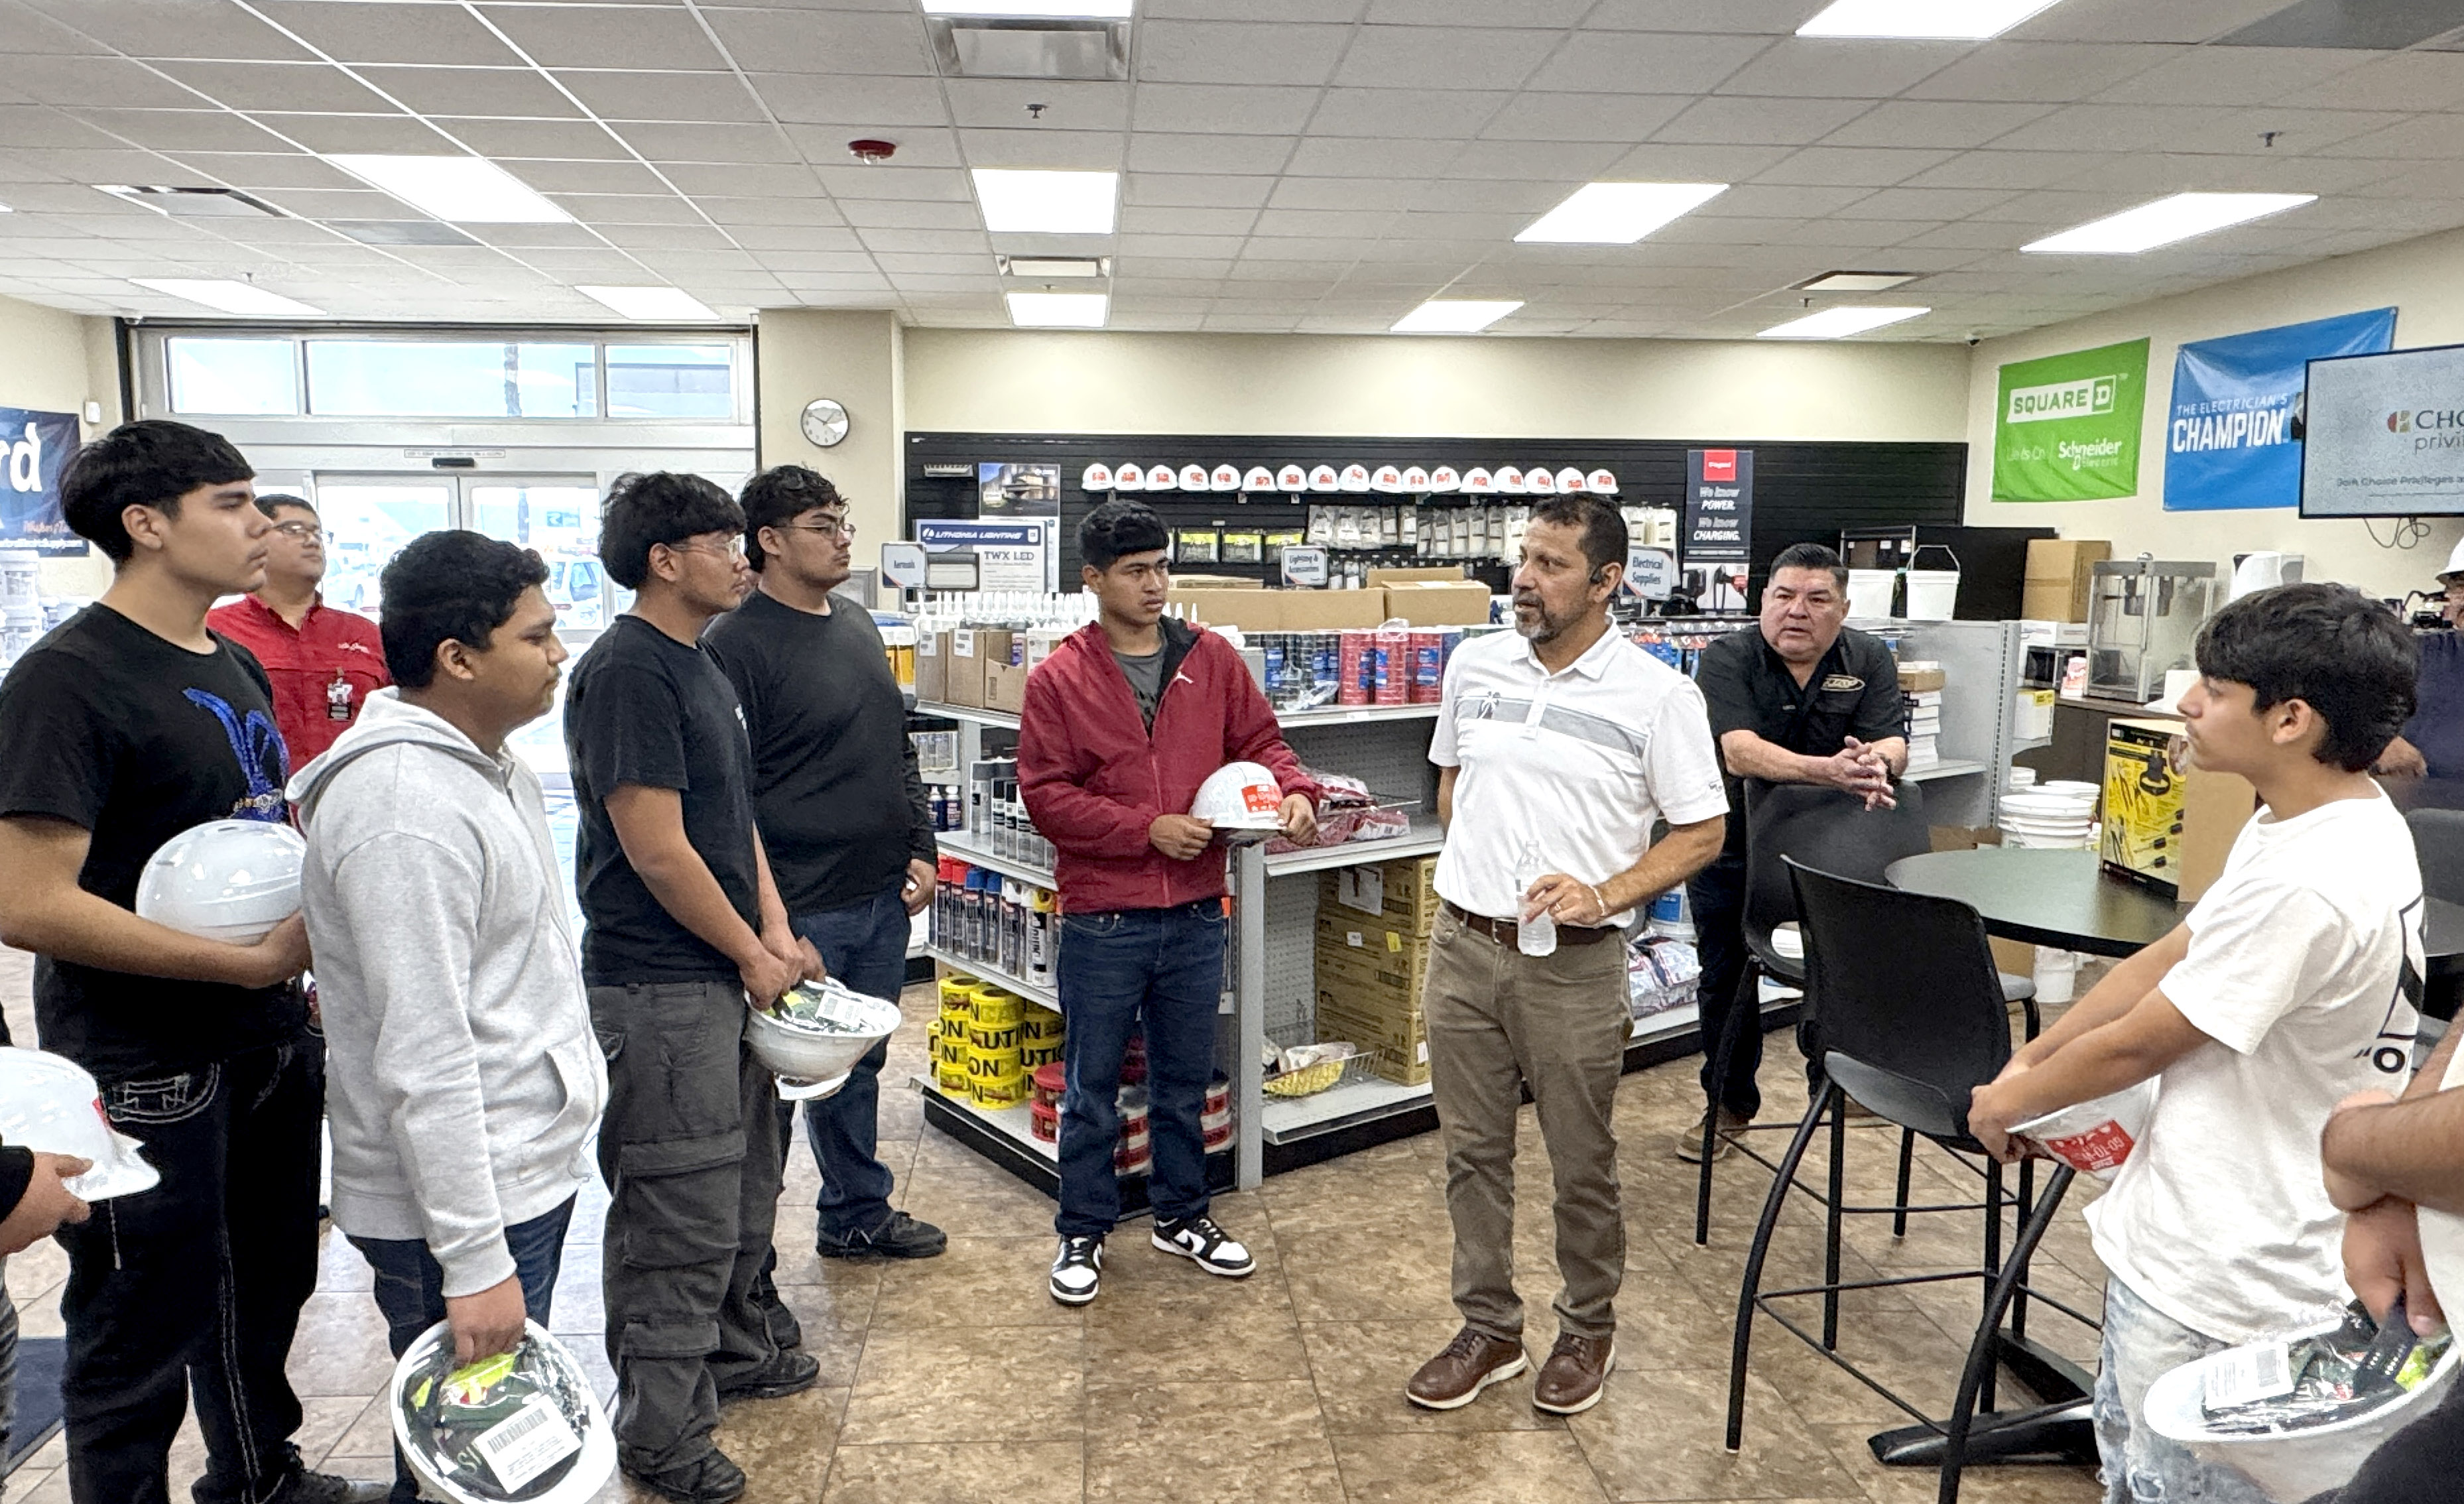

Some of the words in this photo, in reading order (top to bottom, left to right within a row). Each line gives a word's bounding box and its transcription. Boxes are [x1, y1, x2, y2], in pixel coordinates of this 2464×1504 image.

[2014, 389, 2089, 414] SQUARE
[2176, 403, 2197, 417] THE
[2199, 393, 2289, 414] ELECTRICIAN'S
[2172, 407, 2286, 453] CHAMPION
[2058, 437, 2123, 459] Schneider
[984, 551, 1011, 561] TWX
[1013, 552, 1035, 561] LED
